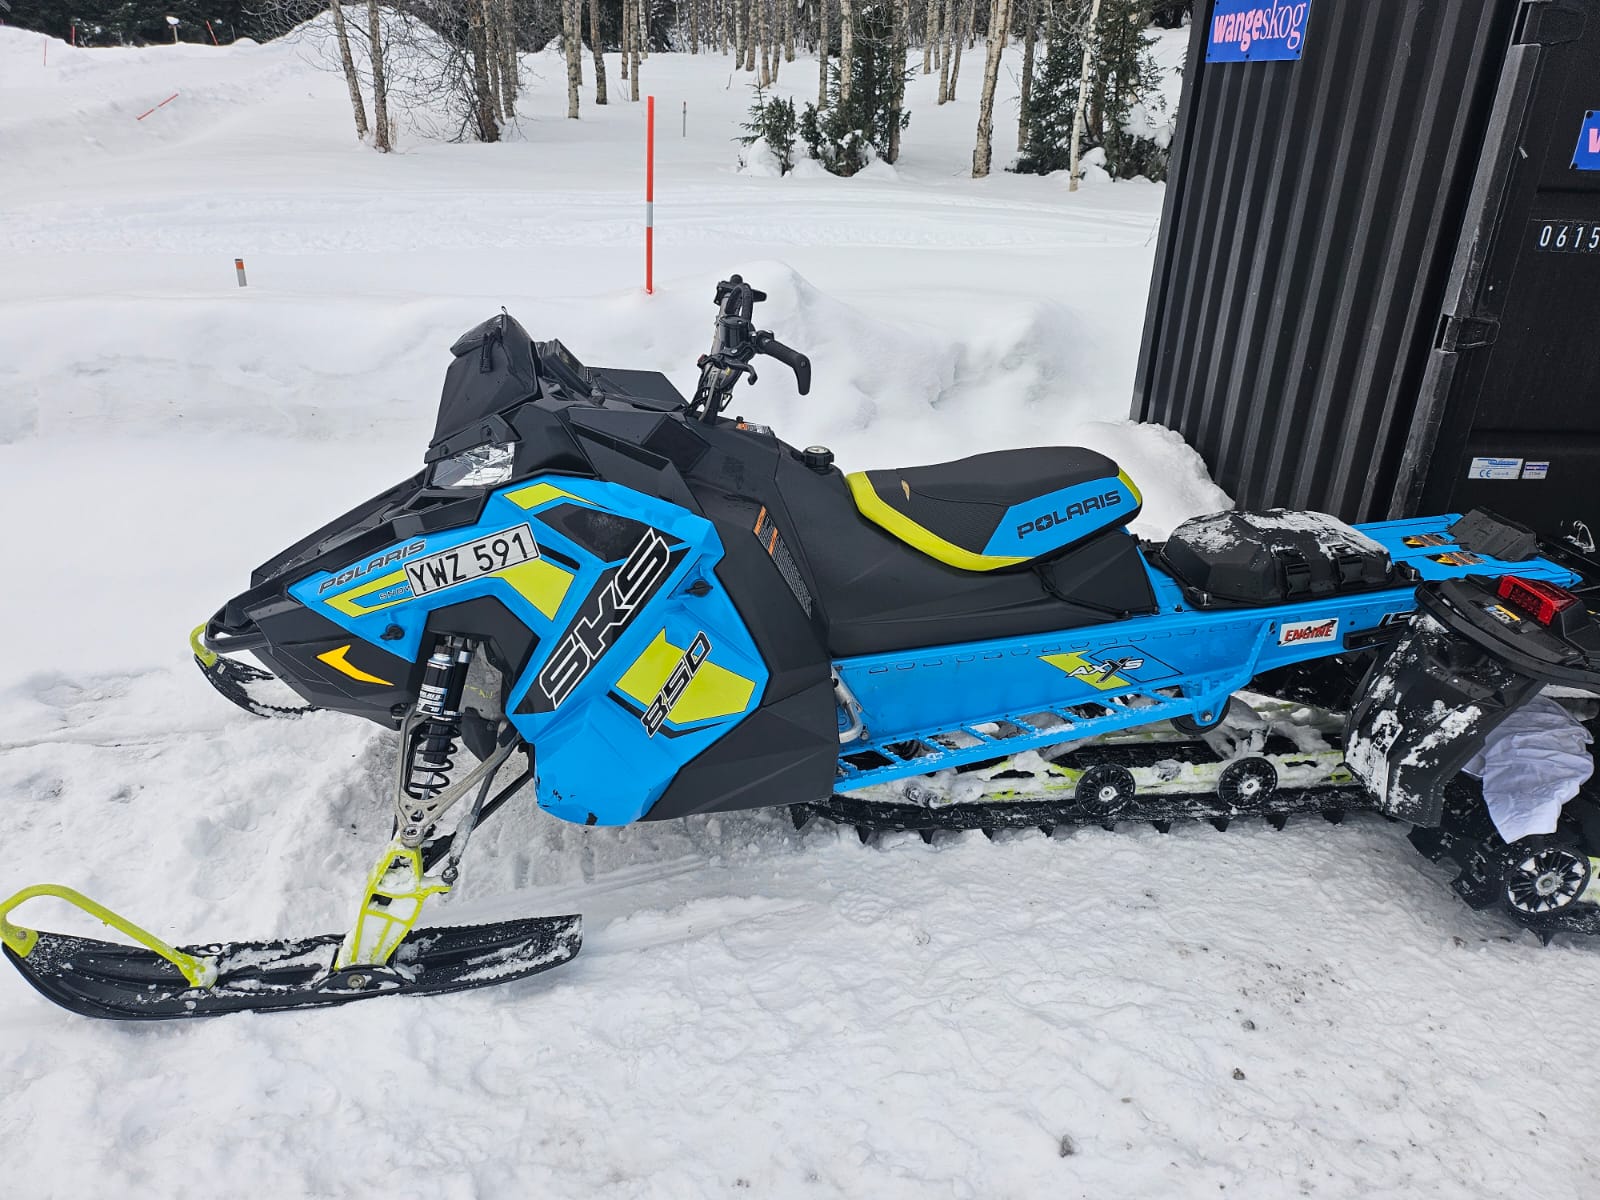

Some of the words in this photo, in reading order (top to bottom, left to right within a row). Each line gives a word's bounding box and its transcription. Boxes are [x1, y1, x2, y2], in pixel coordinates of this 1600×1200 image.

[1213, 0, 1307, 52] wangeskog
[1016, 490, 1122, 540] POLARIS
[317, 538, 427, 594] POLARIS
[409, 552, 467, 592] YWZ
[473, 532, 529, 572] 591
[539, 527, 670, 710] SKS
[1284, 622, 1334, 642] ENGINE
[640, 630, 713, 738] 850
[1064, 656, 1145, 684] AXYS
